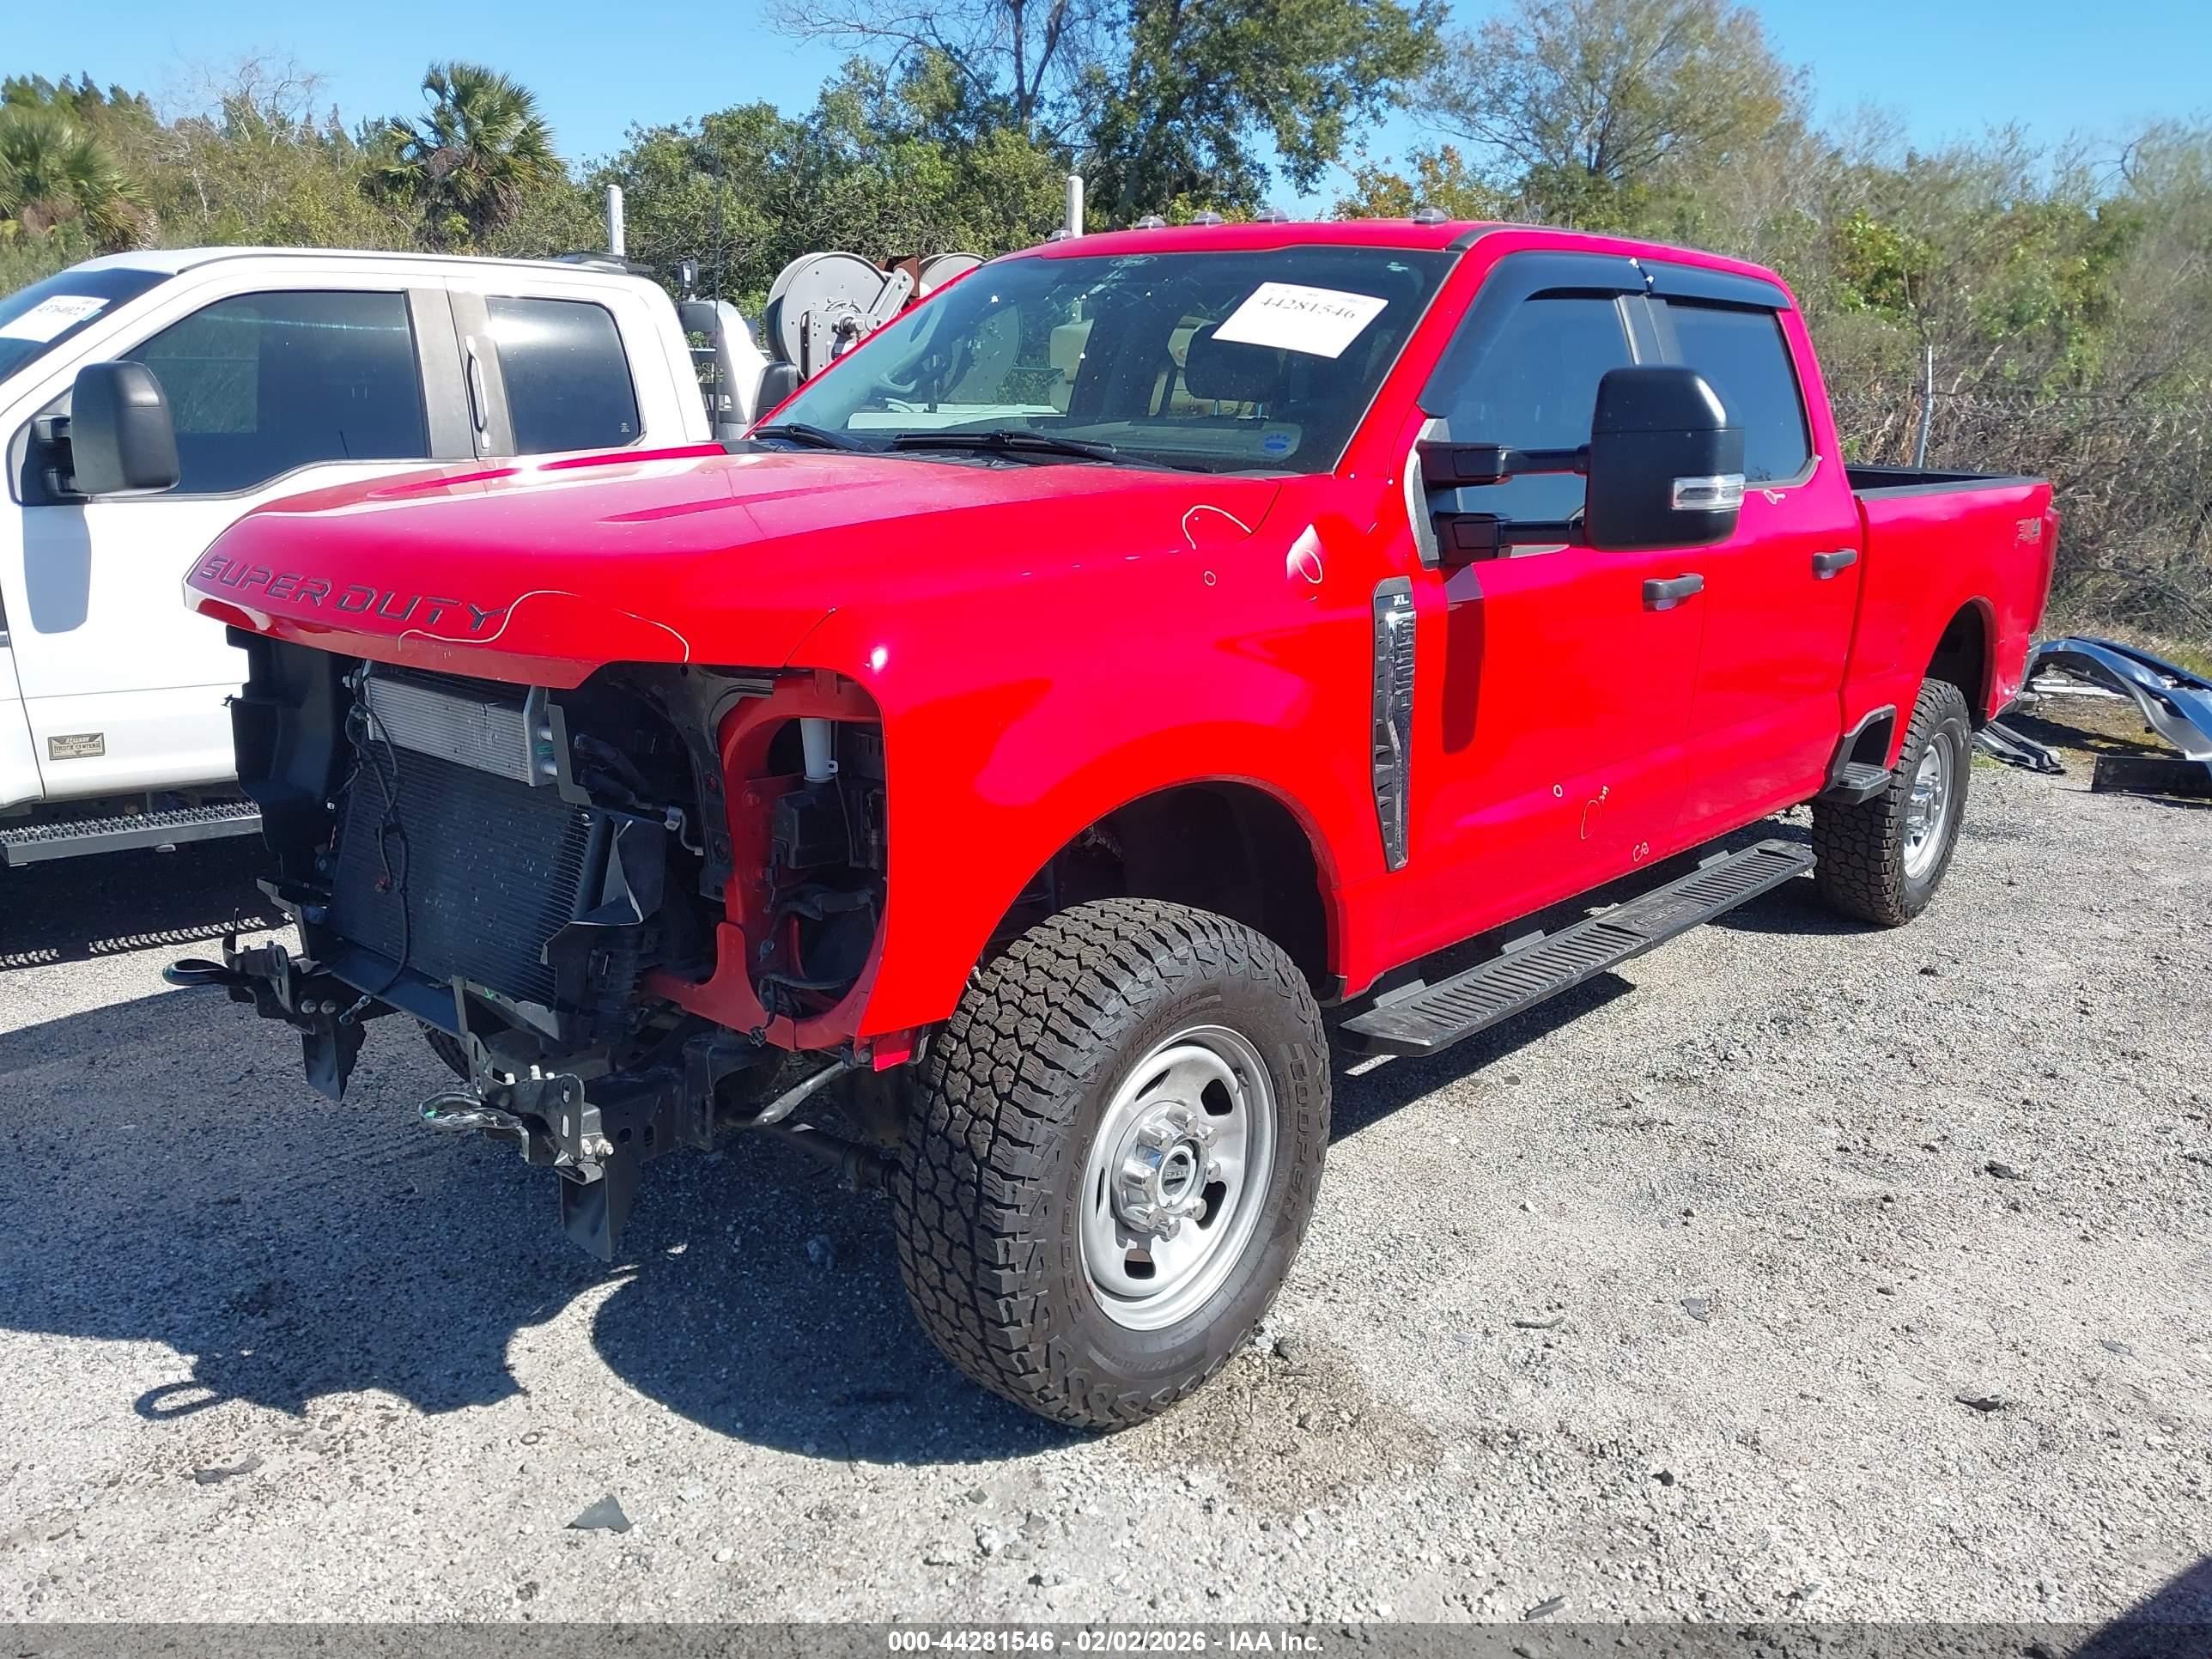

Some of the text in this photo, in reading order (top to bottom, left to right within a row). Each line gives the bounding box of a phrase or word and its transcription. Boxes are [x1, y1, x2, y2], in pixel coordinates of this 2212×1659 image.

[1260, 295, 1357, 319] 44281546
[198, 556, 507, 632] SUPER DUTY
[1393, 593, 1410, 606] XL
[1286, 1057, 1310, 1223] COOPER
